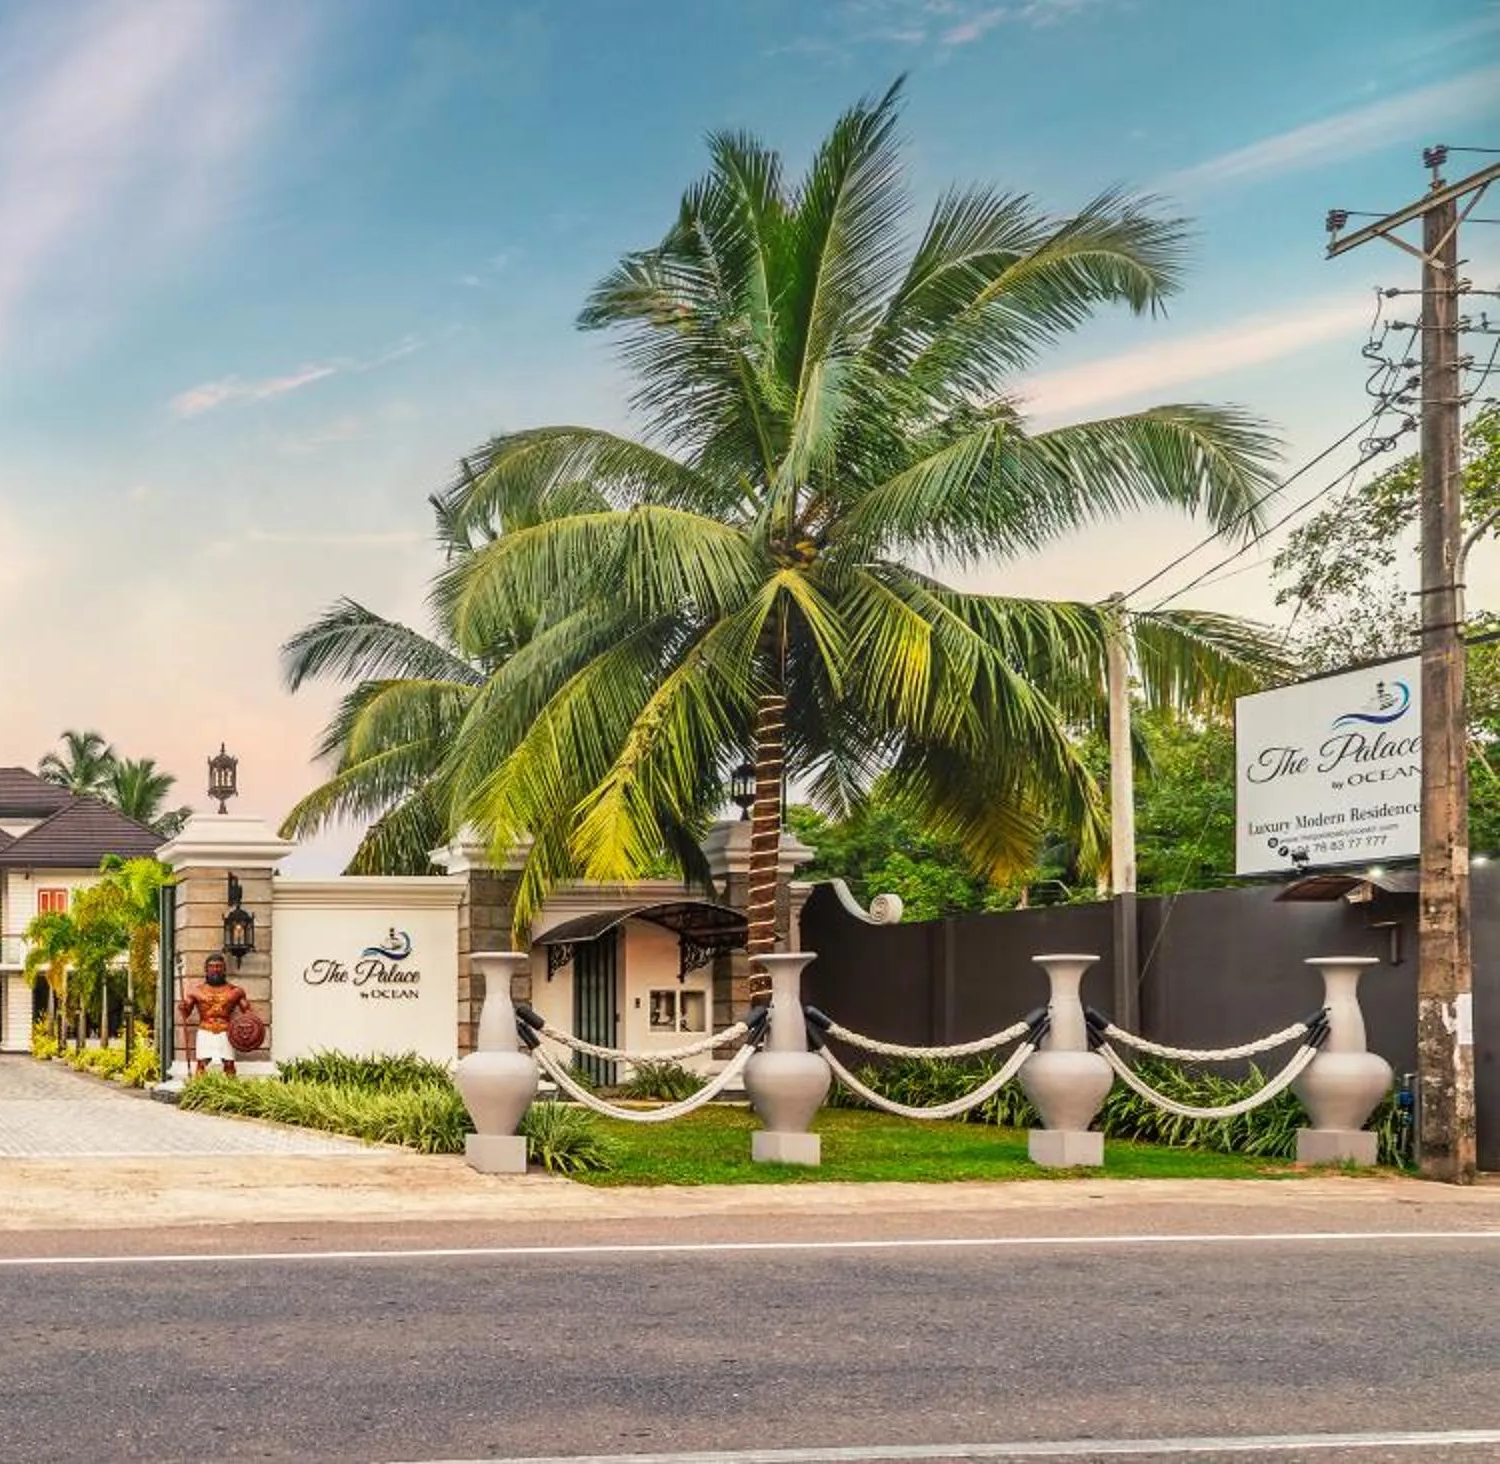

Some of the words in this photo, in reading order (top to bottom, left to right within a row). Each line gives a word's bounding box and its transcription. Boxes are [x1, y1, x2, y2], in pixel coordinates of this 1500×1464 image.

[1247, 746, 1309, 784] The
[1317, 731, 1422, 773] Palace
[1331, 780, 1344, 790] by
[1347, 764, 1422, 786] OCEAN
[1249, 820, 1291, 837] Luxury
[1295, 812, 1345, 829] Modern
[303, 959, 349, 986] The
[352, 959, 421, 987] Palace
[371, 989, 419, 999] OCEAN
